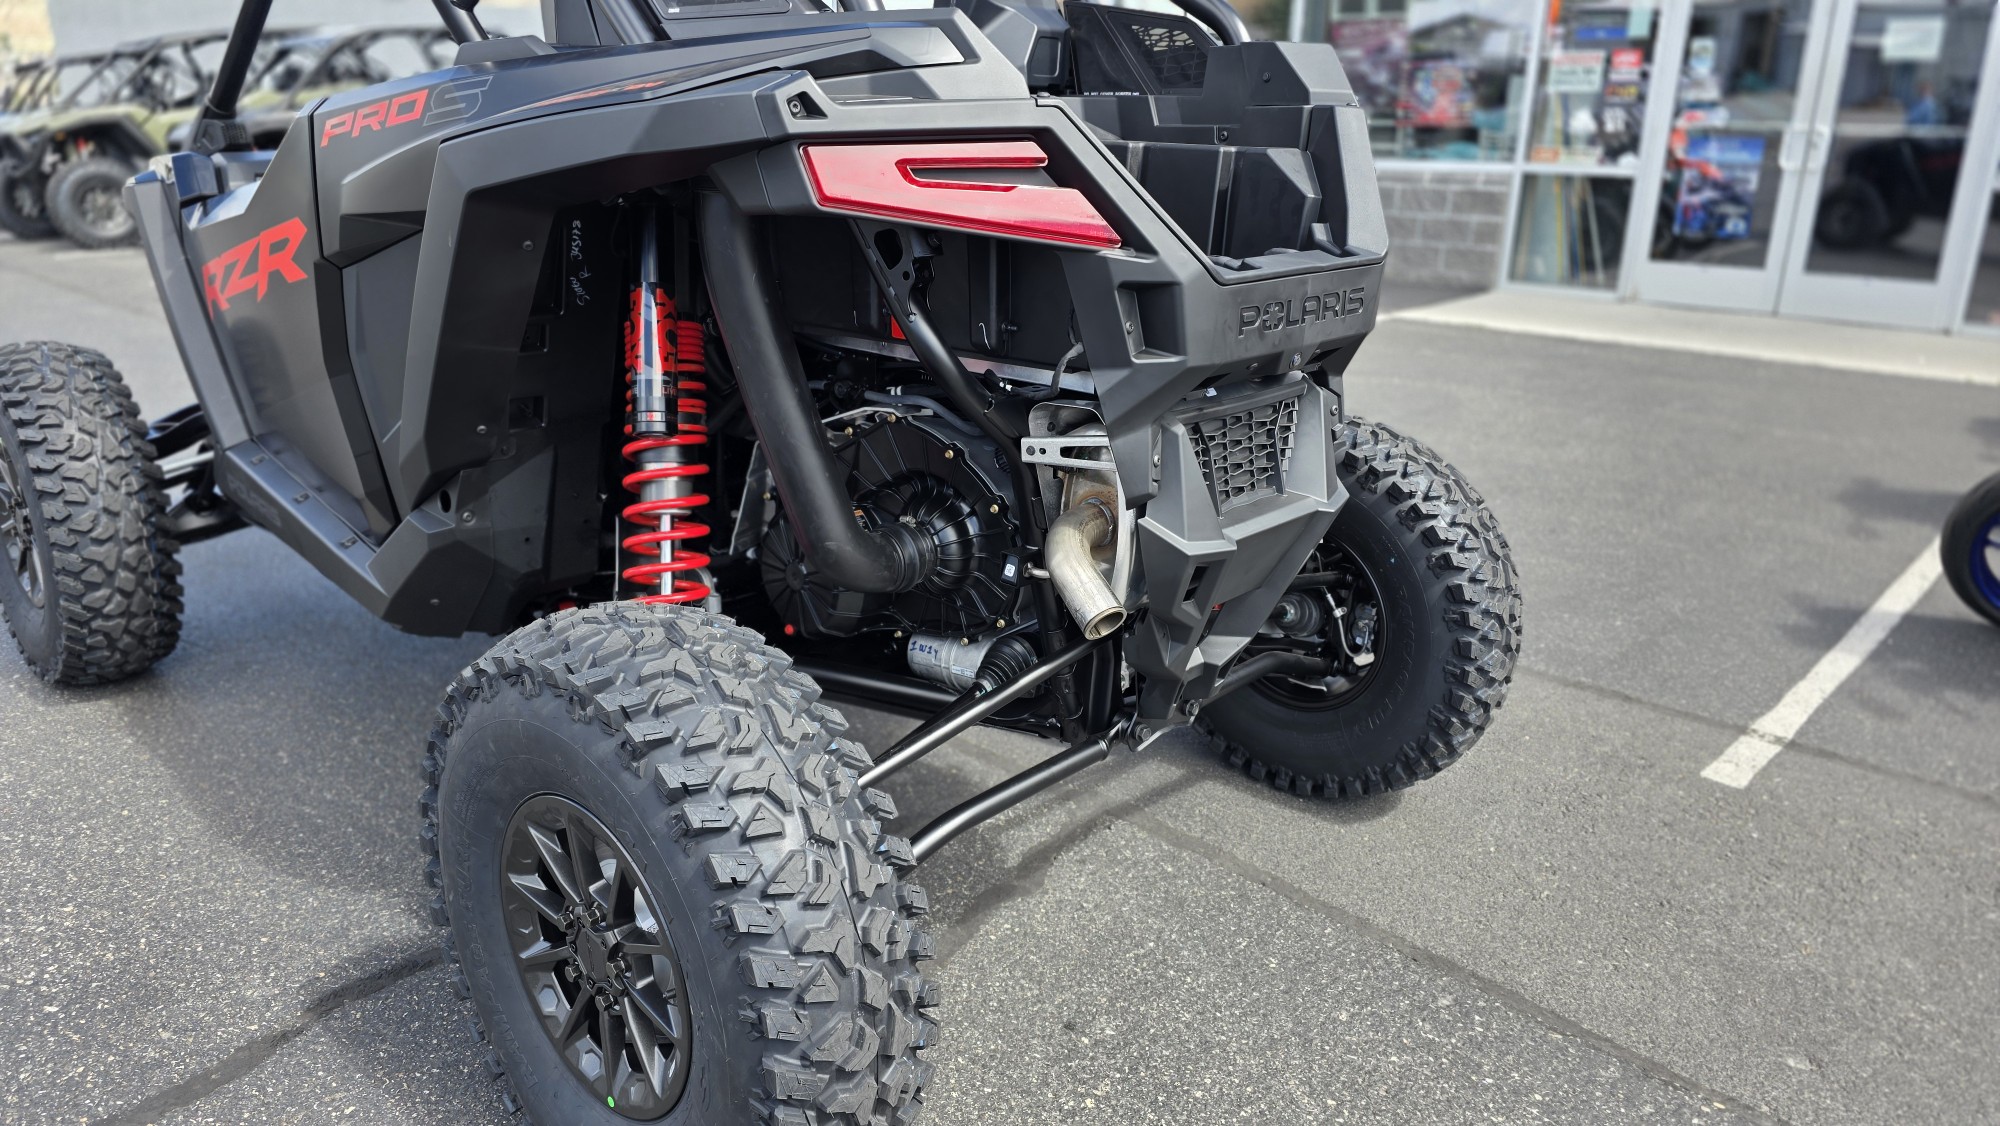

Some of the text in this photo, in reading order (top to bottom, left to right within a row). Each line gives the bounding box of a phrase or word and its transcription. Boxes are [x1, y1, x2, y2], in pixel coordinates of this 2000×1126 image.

[320, 88, 429, 148] PRO
[422, 75, 494, 127] S
[202, 216, 308, 321] RZR
[1238, 286, 1365, 338] POLARIS
